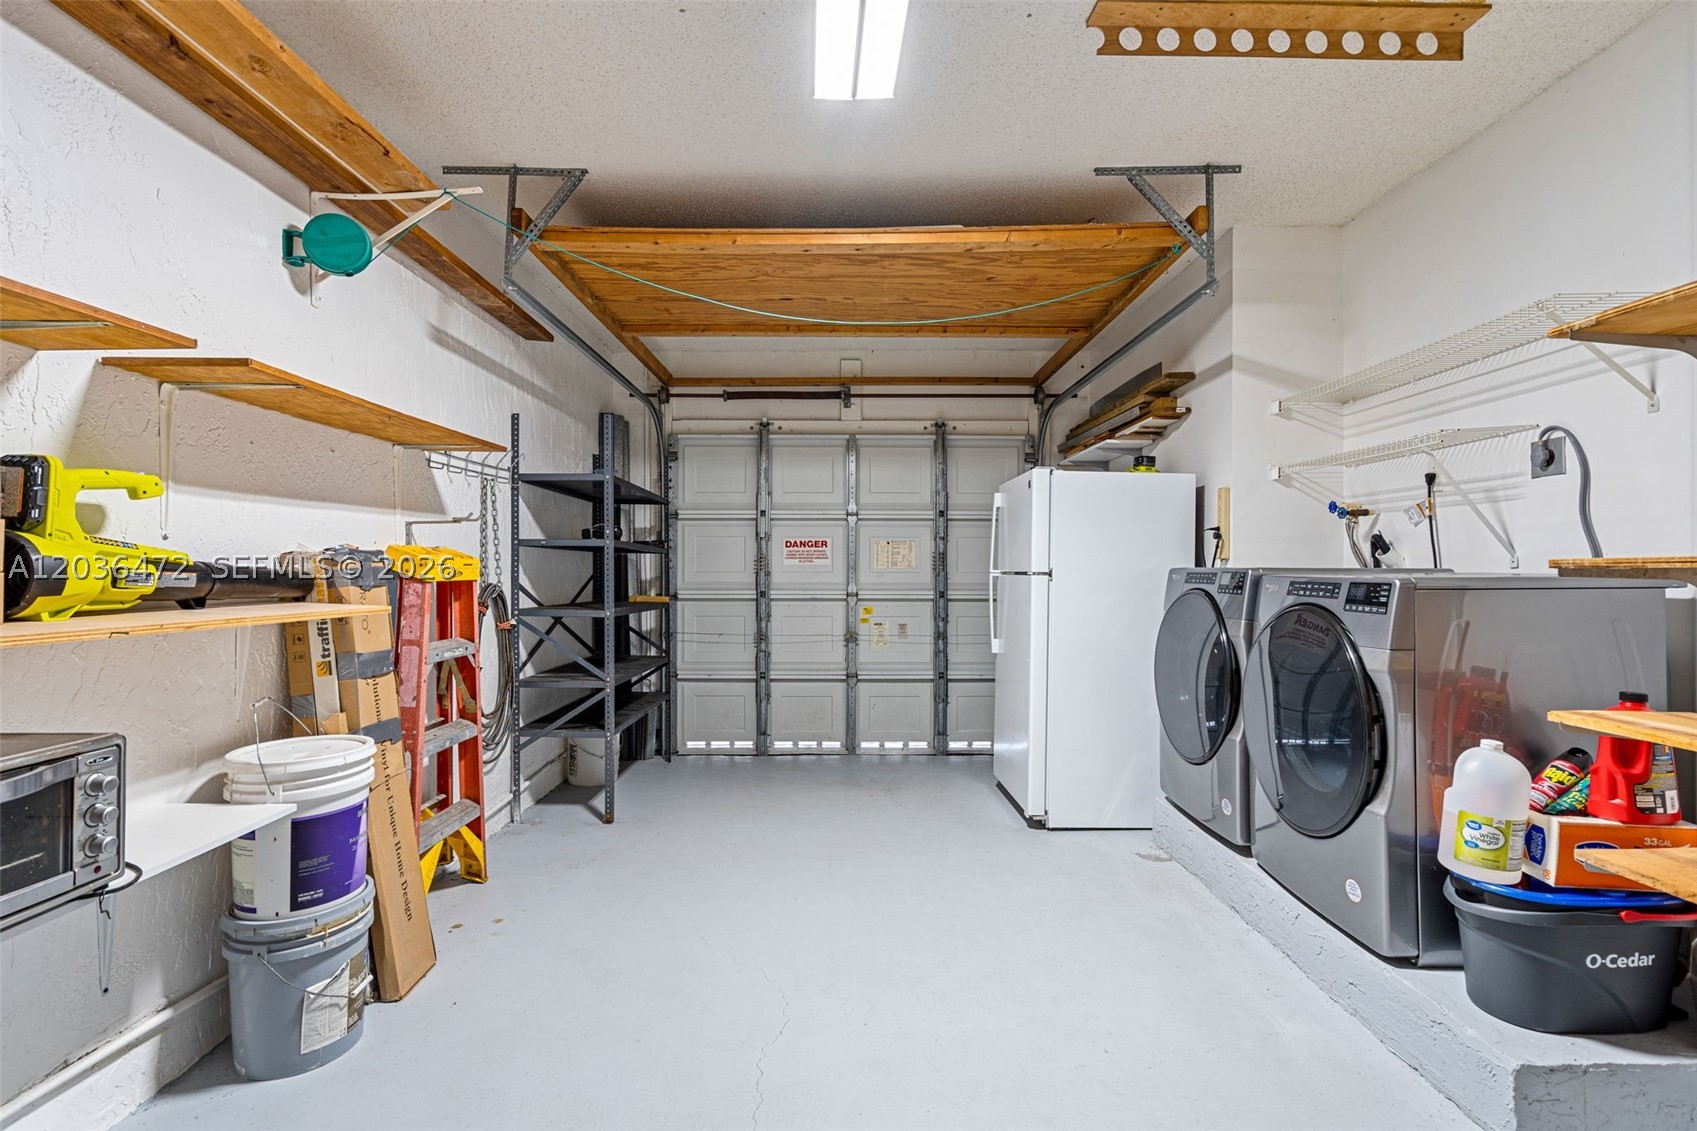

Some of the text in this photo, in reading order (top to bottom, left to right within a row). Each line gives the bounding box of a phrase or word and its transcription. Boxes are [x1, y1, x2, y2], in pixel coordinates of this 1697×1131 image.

[785, 540, 828, 549] DANGER
[381, 740, 389, 770] Vinyl
[384, 774, 392, 792] for
[1543, 767, 1577, 786] Raid
[387, 795, 398, 838] Unique
[1469, 834, 1500, 846] Vinegar
[1479, 832, 1500, 841] White
[1644, 837, 1658, 846] 33
[394, 840, 405, 878] Home
[401, 880, 413, 921] Design
[1585, 952, 1656, 969] O-Cedar
